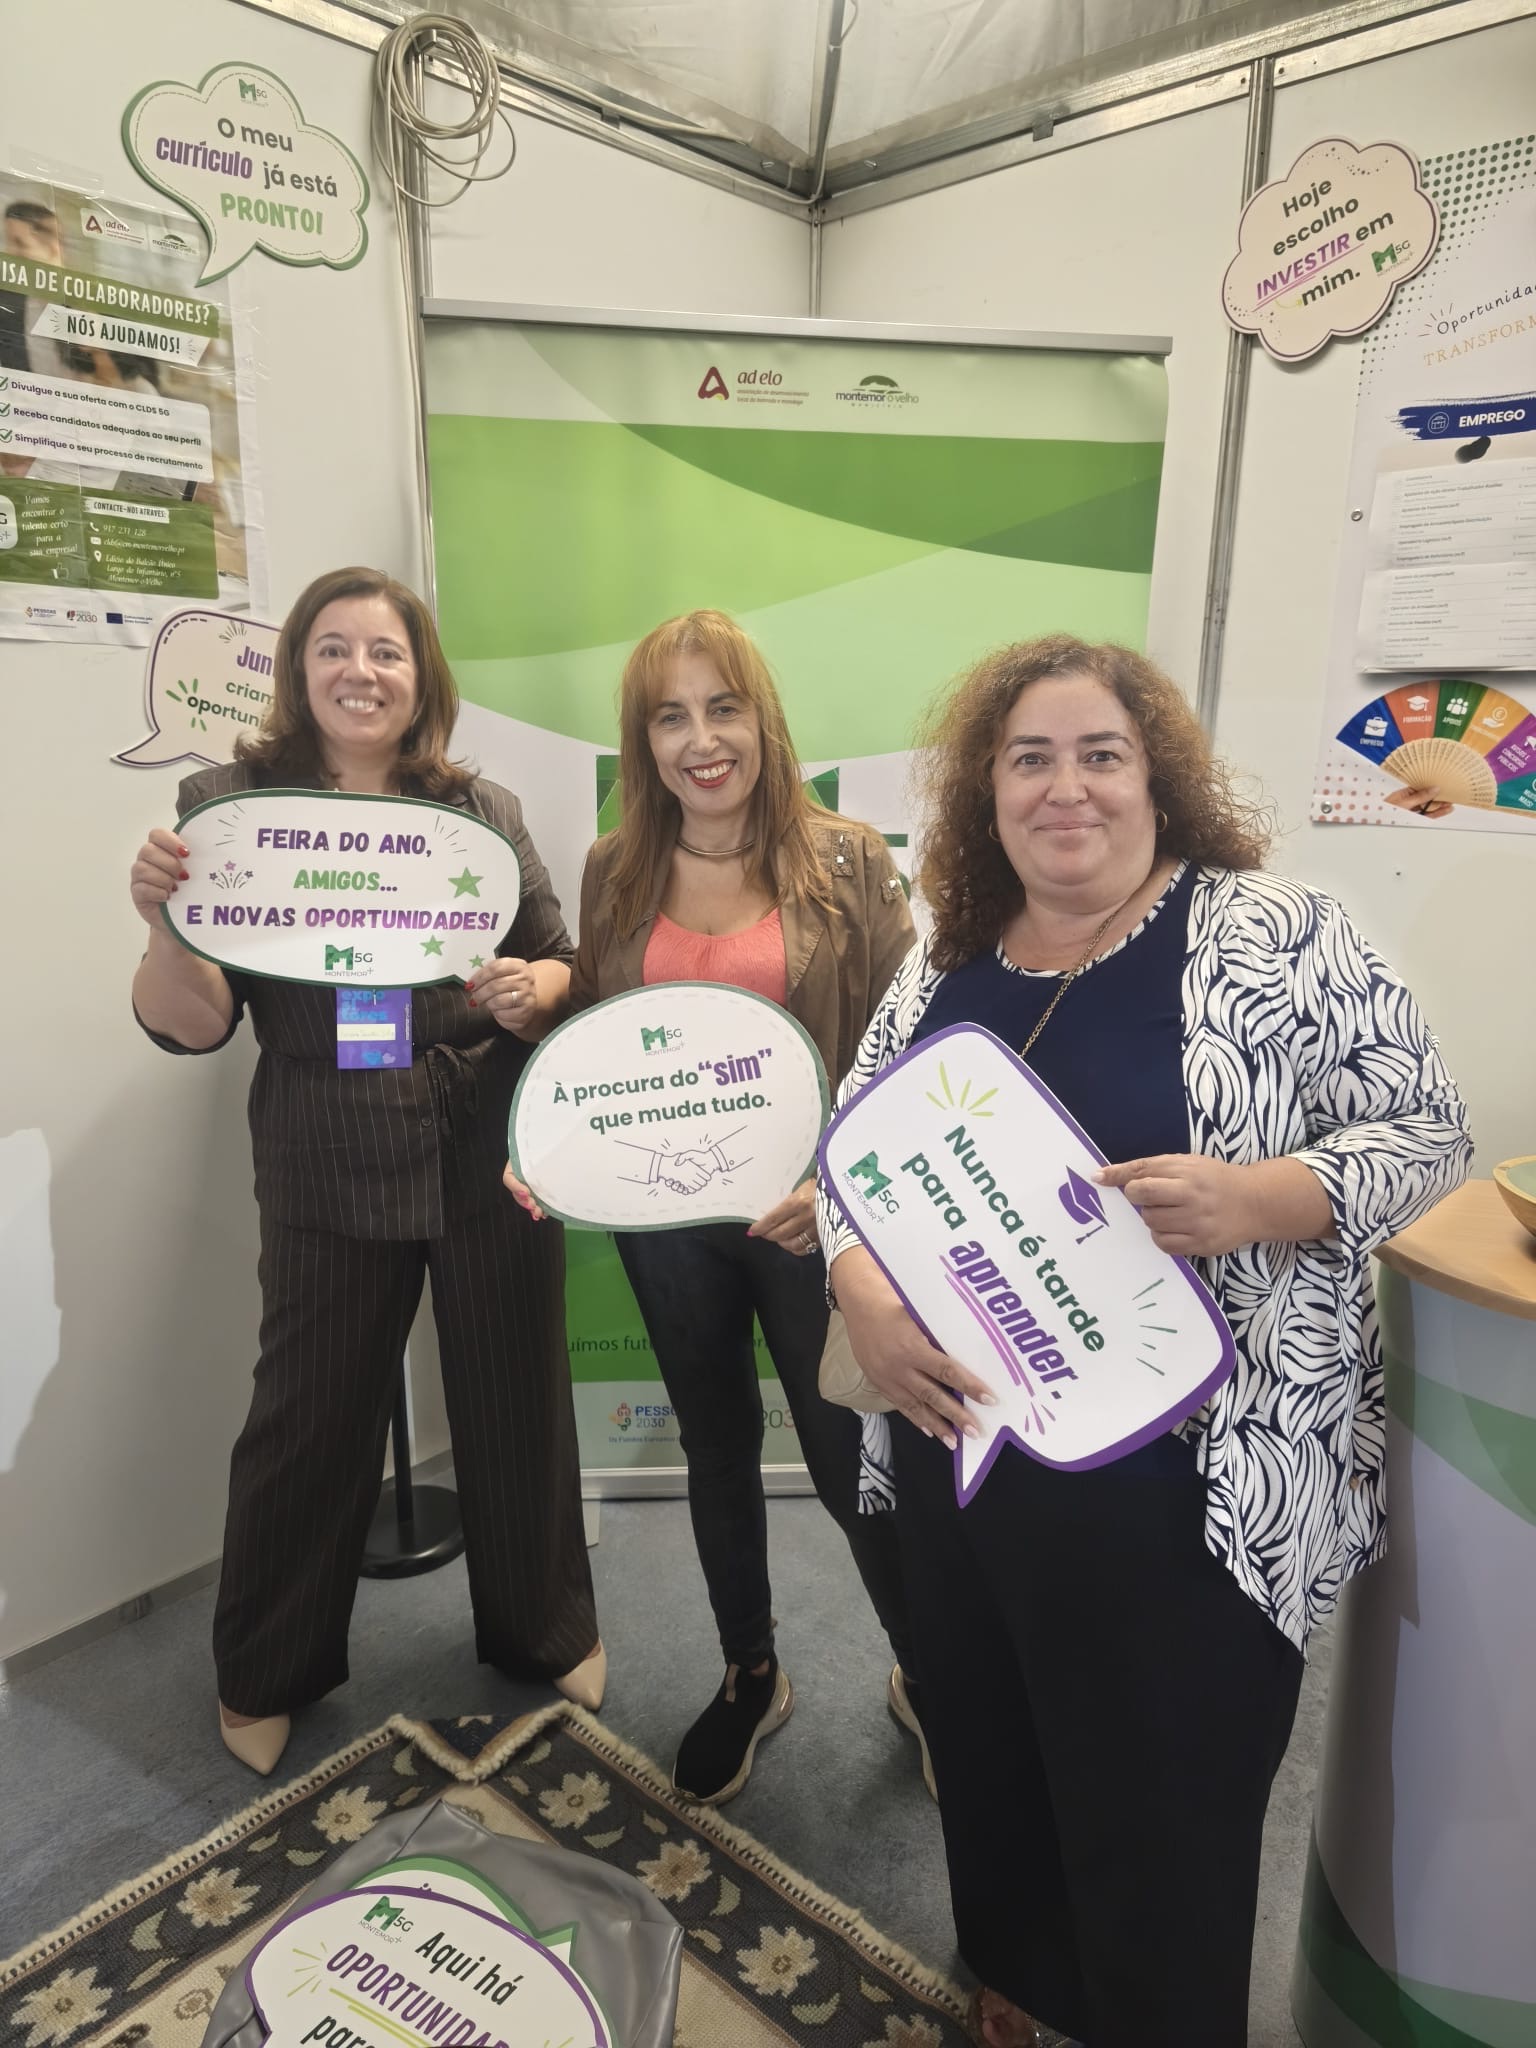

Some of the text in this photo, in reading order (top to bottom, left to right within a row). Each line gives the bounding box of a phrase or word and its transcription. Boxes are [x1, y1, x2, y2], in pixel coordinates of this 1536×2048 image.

[217, 118, 293, 152] O meu
[156, 137, 338, 198] currículo já está
[220, 192, 323, 236] PRONTO!
[1282, 178, 1333, 218] Hoje
[1272, 198, 1360, 256] escolho
[1256, 211, 1394, 300] INVESTIR em
[2, 260, 210, 326] ISA DE COLABORADORES?
[1301, 264, 1361, 306] mim.
[67, 314, 181, 355] NÓS AJUDAMOS!
[11, 381, 53, 397] Divulgue
[54, 390, 61, 398] a
[62, 391, 79, 401] sua
[80, 393, 107, 406] oferta
[108, 400, 128, 410] com
[135, 403, 158, 415] CLDS
[158, 408, 170, 417] 5G
[835, 391, 887, 402] montemor
[894, 392, 920, 404] velho
[13, 407, 202, 447] Receba candidatos adequados ao seu perfil
[1458, 408, 1526, 428] EMPREGO
[14, 433, 68, 450] Simplifique
[76, 444, 93, 453] seu
[94, 446, 134, 460] processo
[134, 450, 145, 461] de
[146, 455, 204, 470] recrutamento
[236, 645, 273, 676] Jun
[257, 828, 433, 858] FEIRA DO ANO,
[293, 869, 398, 892] AMIGOS...
[186, 904, 499, 931] E NOVAS OPORTUNIDADES!
[354, 952, 374, 964] 5G
[666, 1028, 683, 1039] 5G
[553, 1081, 569, 1104] À
[574, 1074, 664, 1107] procura
[670, 1068, 699, 1089] do
[589, 1092, 773, 1135] que muda tudo.
[877, 1190, 900, 1215] 5G
[901, 1152, 967, 1231] para
[943, 1125, 1105, 1353] Nunca é tarde
[948, 1240, 1080, 1400] aprender.
[636, 1418, 666, 1428] 2030
[393, 1916, 414, 1933] 5G
[415, 1931, 525, 2006] Aqui há
[300, 2015, 376, 2048] par
